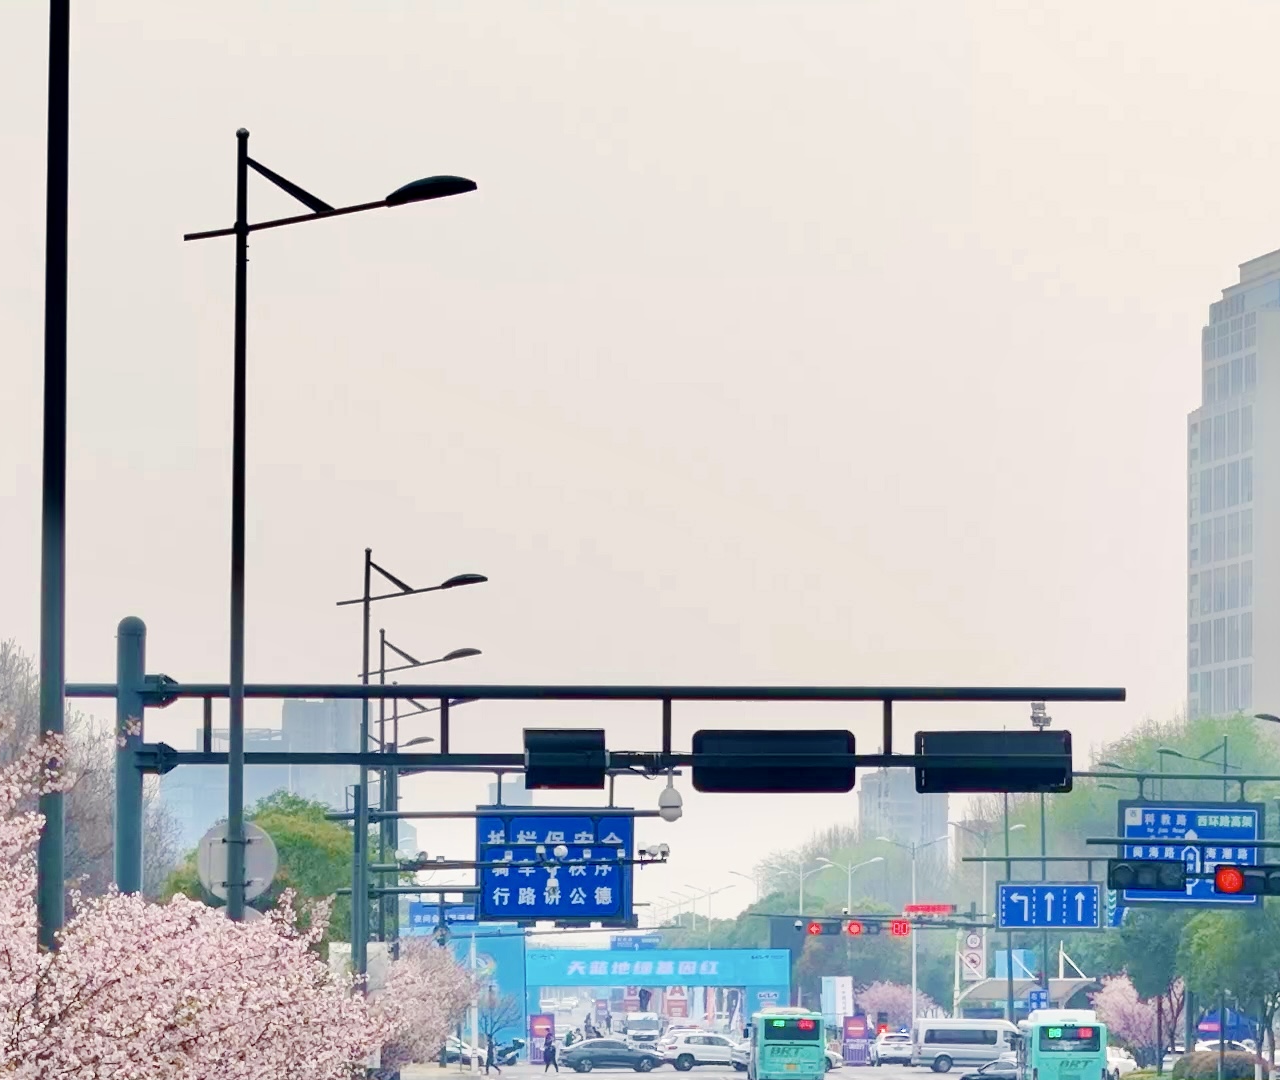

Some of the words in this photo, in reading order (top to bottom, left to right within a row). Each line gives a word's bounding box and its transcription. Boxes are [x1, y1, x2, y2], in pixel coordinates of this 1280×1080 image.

[493, 886, 612, 905] 行路讲公德
[770, 1047, 804, 1058] BRT
